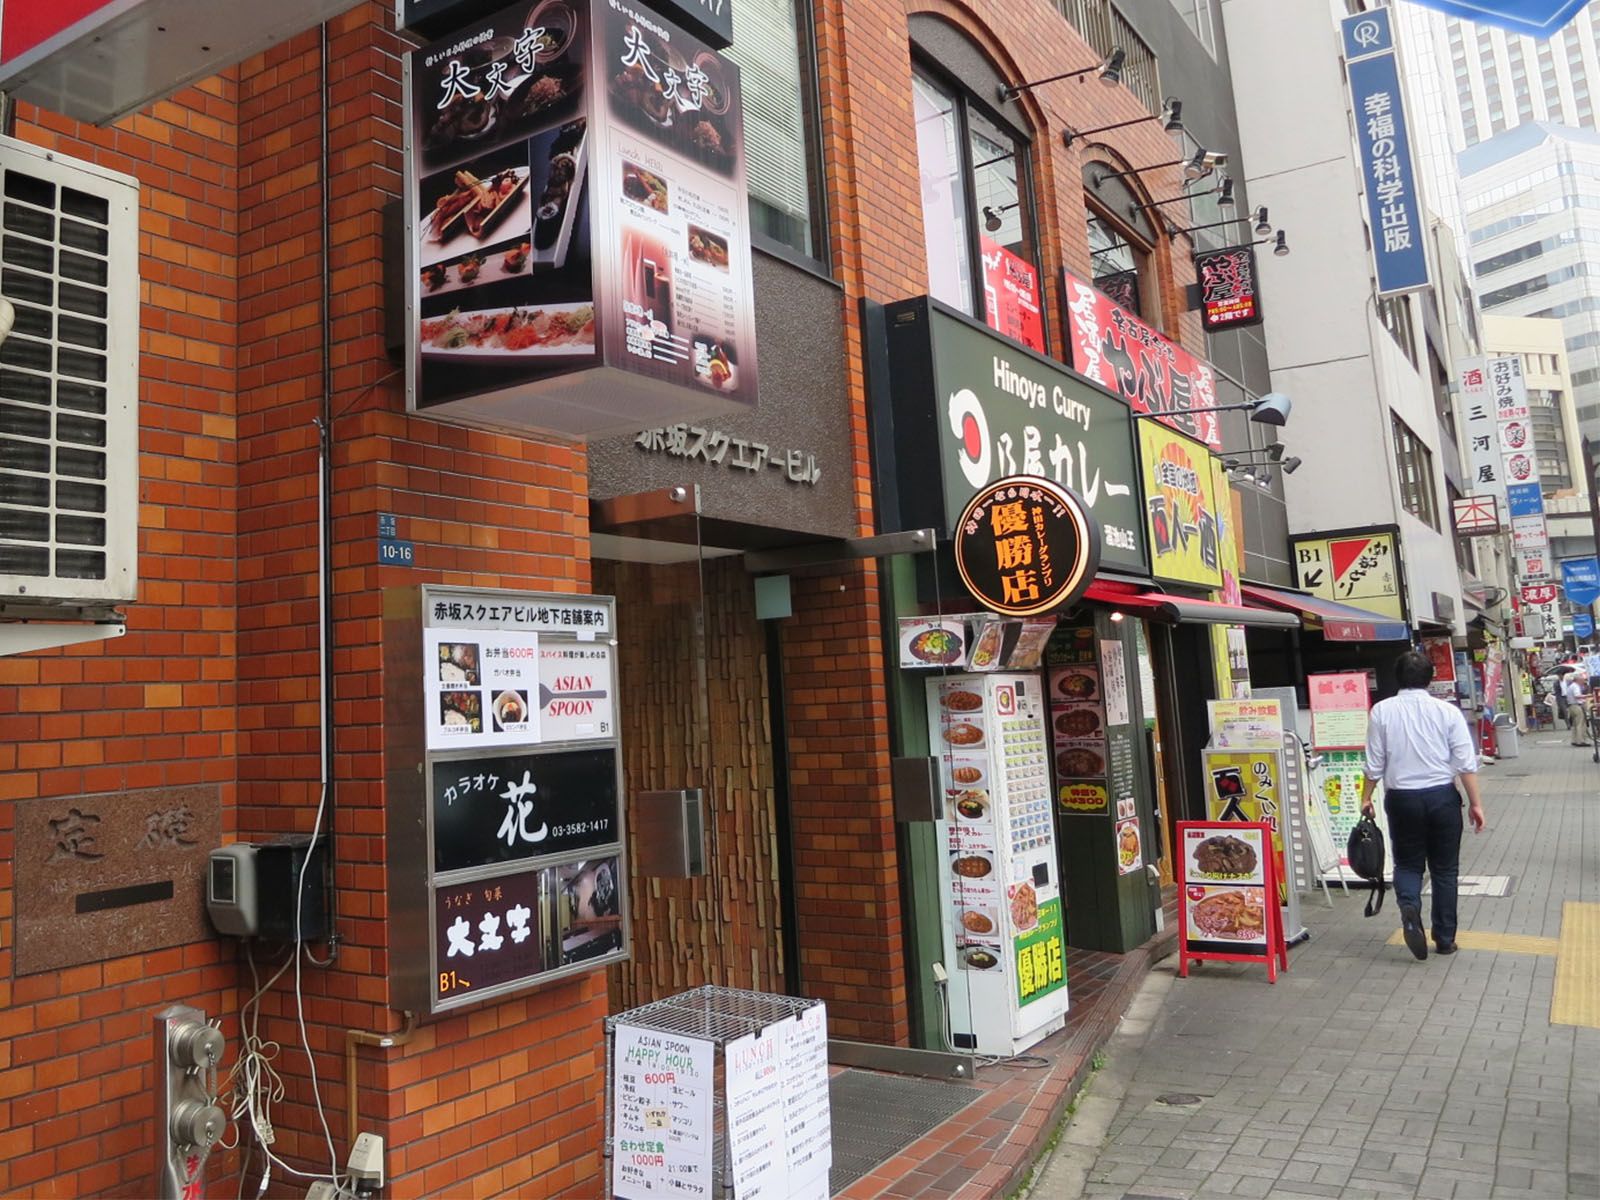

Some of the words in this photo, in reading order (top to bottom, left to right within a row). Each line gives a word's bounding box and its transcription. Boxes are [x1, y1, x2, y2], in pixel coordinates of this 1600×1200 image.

[437, 27, 545, 109] 大文字
[621, 26, 709, 111] 大文字
[1364, 91, 1411, 252] 幸福の科学出版
[1463, 368, 1483, 387] 酒
[1494, 361, 1514, 408] お好み焼
[993, 356, 1046, 408] Hinoya
[1053, 386, 1090, 431] Curry
[1469, 405, 1496, 483] 三河屋
[382, 545, 412, 560] 10-16
[991, 500, 1039, 605] 優勝店
[1031, 506, 1052, 587] 神田カレーグランプリ
[1299, 548, 1321, 563] B1
[434, 602, 605, 626] 赤坂スクエアビル地下店舗案内
[485, 647, 534, 659] お弁当600円
[540, 650, 606, 660] スパイス料理が楽しめる店
[553, 676, 593, 691] ASIAN
[549, 701, 594, 717] SPOON
[600, 722, 609, 733] B1
[444, 773, 500, 806] カラオケ
[1254, 762, 1278, 832] のみくい処
[496, 770, 549, 847] 花
[47, 808, 105, 865] 定
[552, 818, 609, 838] 03-3582-1417
[445, 893, 473, 909] うなぎ
[446, 903, 531, 958] 大文字
[1018, 935, 1063, 998] 優勝店
[439, 971, 457, 992] B1
[638, 1036, 661, 1048] ASIAN
[665, 1041, 690, 1053] SPOON
[734, 1039, 773, 1069] LUNCH
[628, 1046, 660, 1063] HAPPY
[665, 1054, 693, 1069] HOUR
[645, 1073, 676, 1084] 600円
[620, 1140, 664, 1153] 合わせ定食
[621, 1164, 644, 1177] お好きな
[632, 1154, 664, 1167] 1000円
